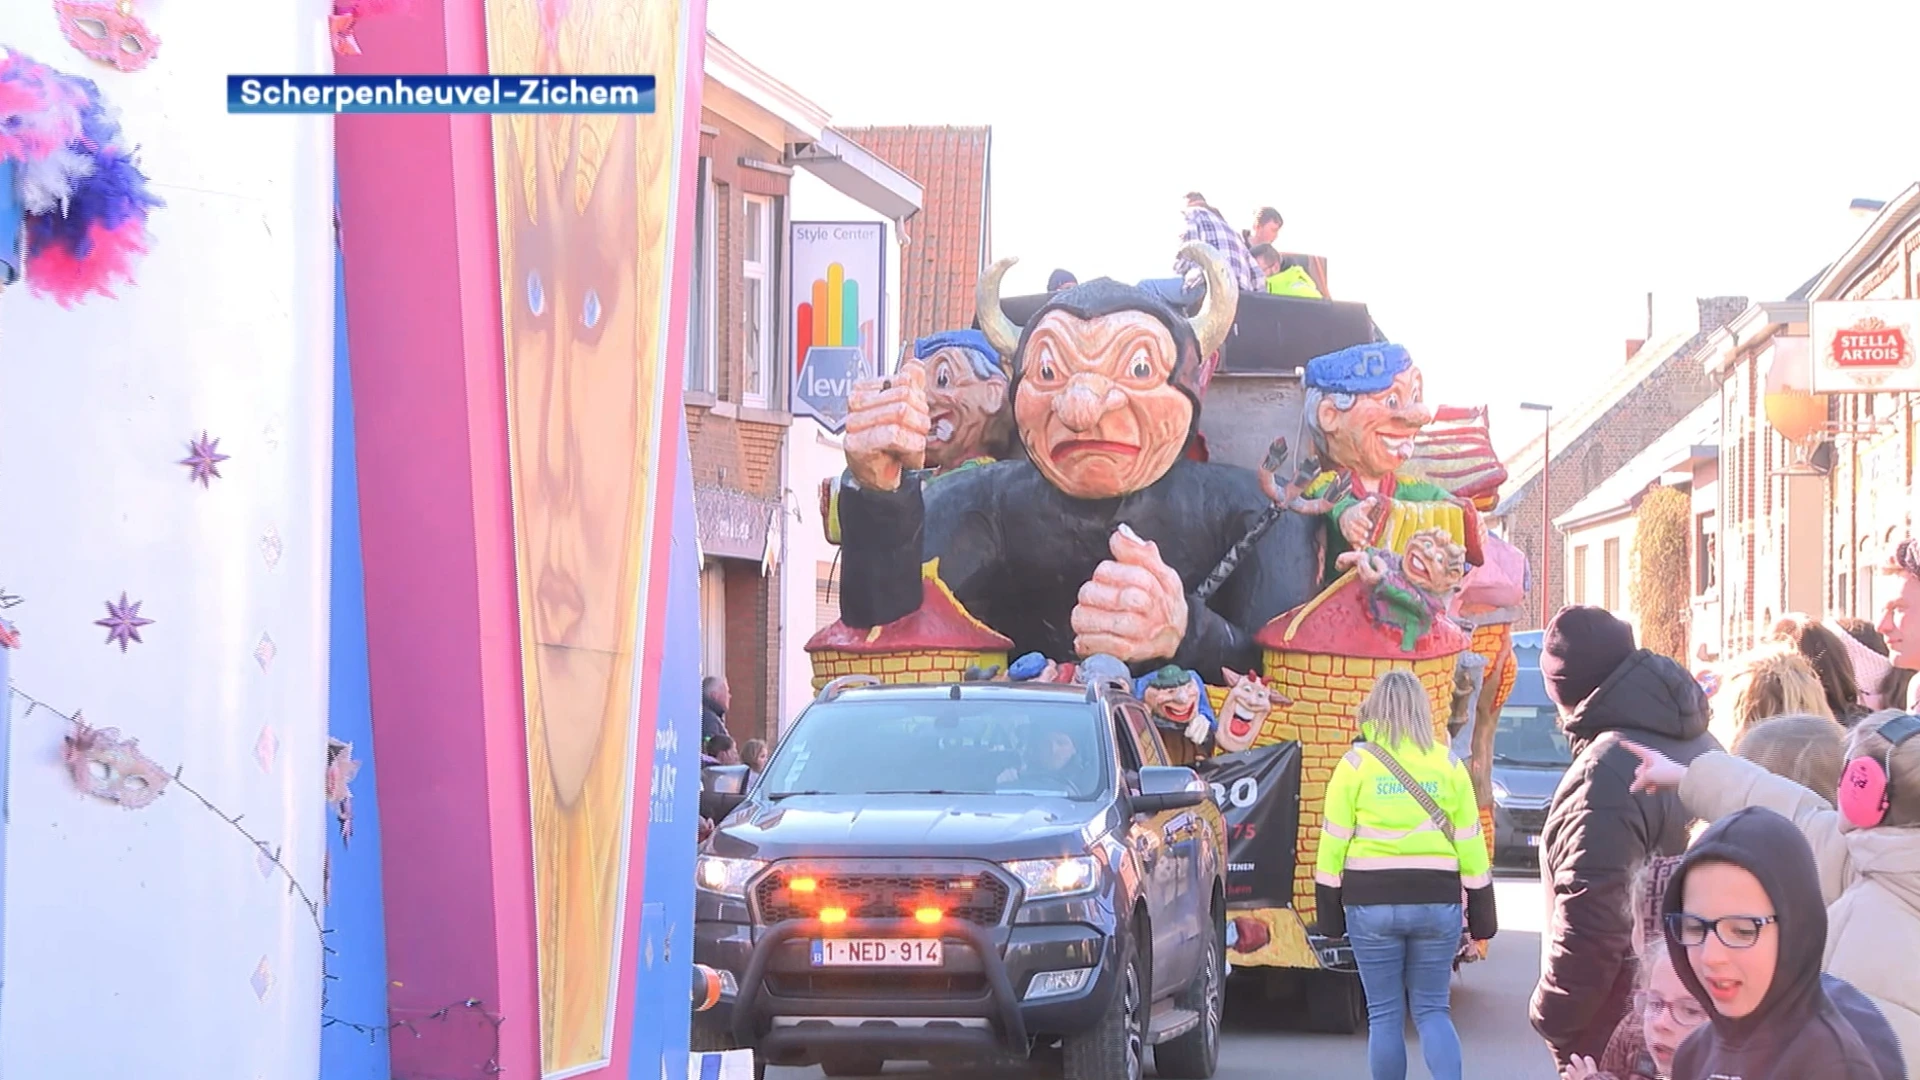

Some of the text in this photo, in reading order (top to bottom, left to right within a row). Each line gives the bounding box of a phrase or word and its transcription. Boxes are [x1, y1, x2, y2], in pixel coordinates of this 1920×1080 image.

[797, 227, 875, 243] Style Center
[1841, 334, 1898, 347] STELLA
[1841, 347, 1899, 360] ARTOIS
[807, 365, 852, 397] levi
[826, 942, 938, 961] 1-NED-914
